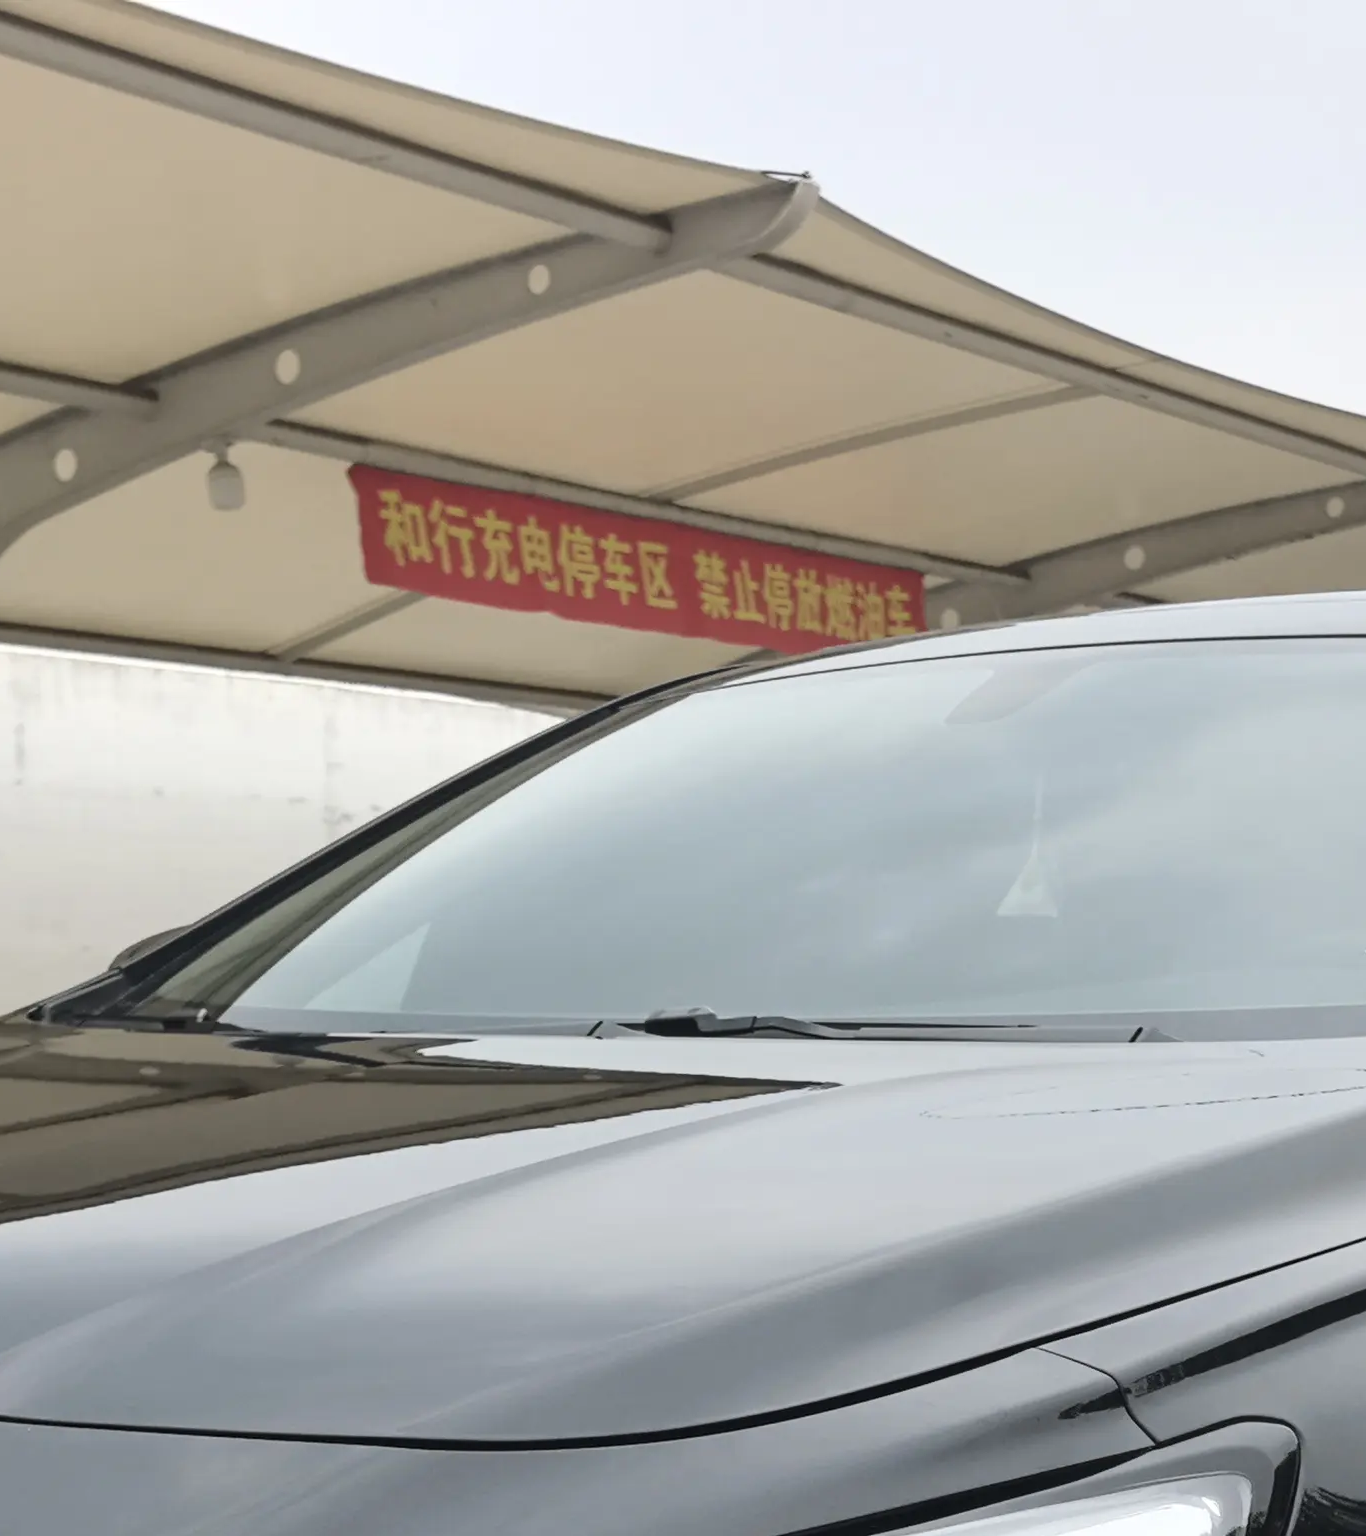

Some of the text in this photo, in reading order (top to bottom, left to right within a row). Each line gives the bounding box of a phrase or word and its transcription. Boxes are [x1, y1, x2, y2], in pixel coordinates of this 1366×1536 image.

[377, 488, 917, 642] 和行充电停车区 禁止停放燃油车
